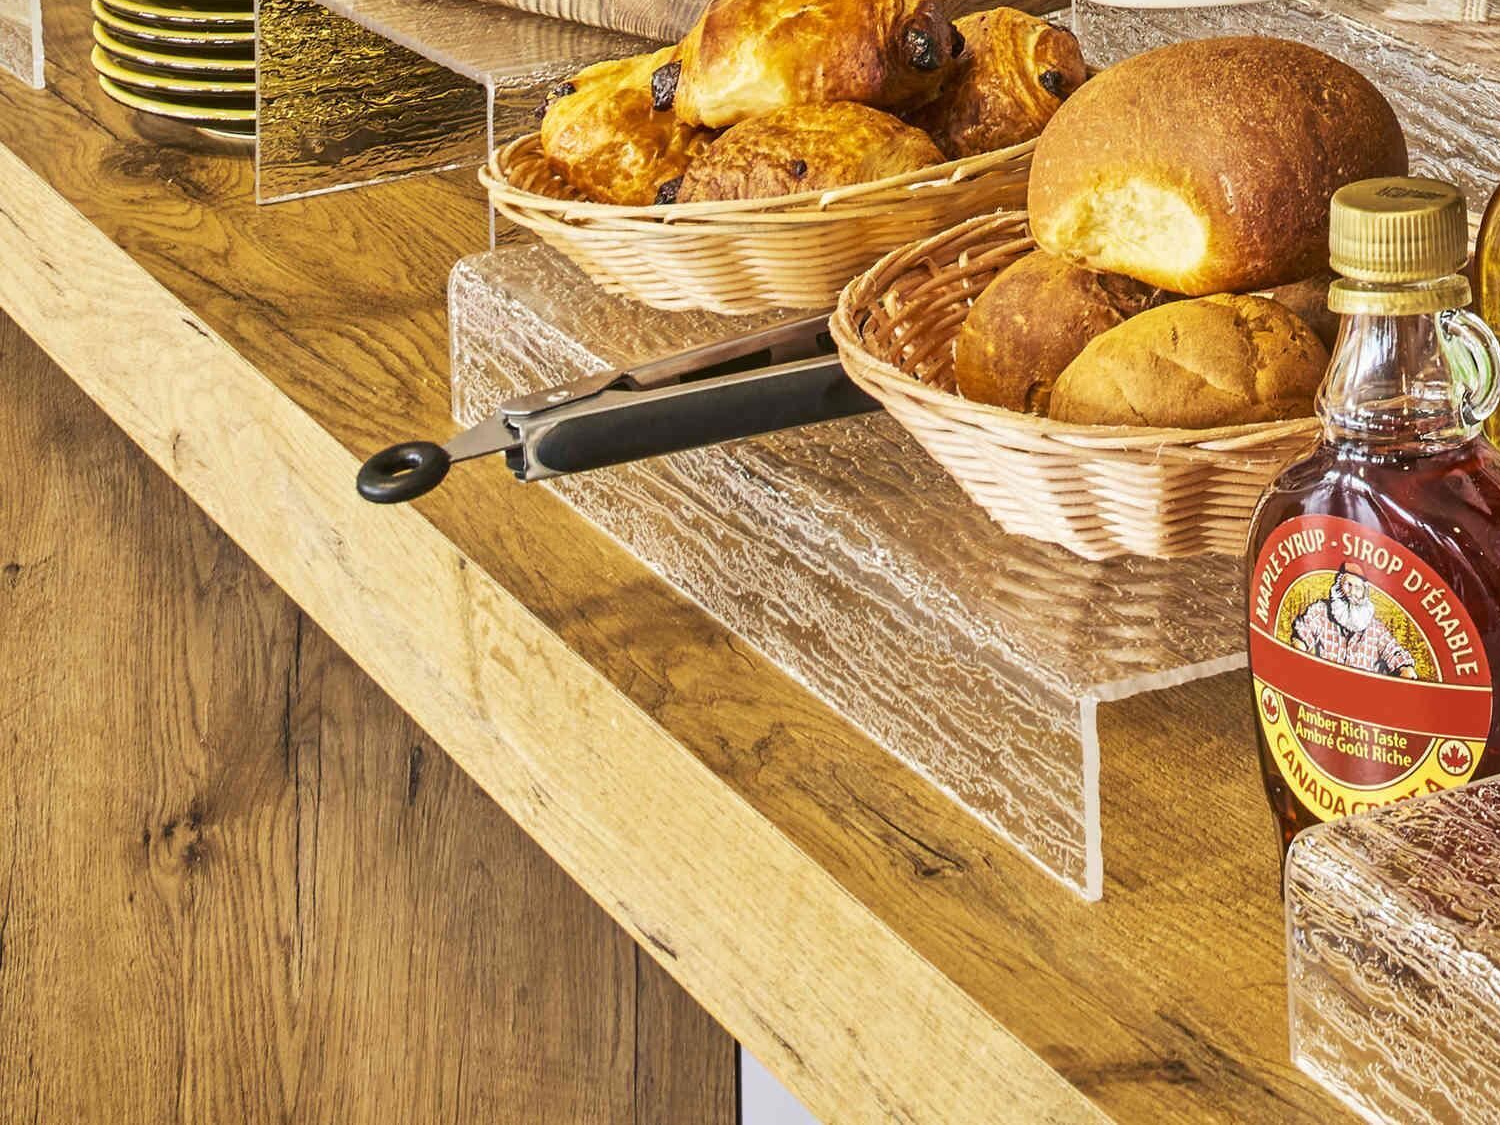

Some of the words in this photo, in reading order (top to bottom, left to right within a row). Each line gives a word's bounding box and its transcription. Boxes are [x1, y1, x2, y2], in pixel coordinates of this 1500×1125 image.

[1256, 552, 1283, 624] MAPLE
[1278, 529, 1325, 565] SYRUP
[1342, 533, 1403, 575] SIROP
[1404, 567, 1479, 677] D'ÉRABLE
[1295, 721, 1334, 748] Ambré
[1336, 737, 1369, 760] Goût
[1372, 746, 1412, 767] Riche
[1298, 705, 1338, 731] Amber
[1340, 720, 1369, 742] Rich
[1373, 728, 1407, 749] Taste
[1276, 732, 1347, 817] CANADA
